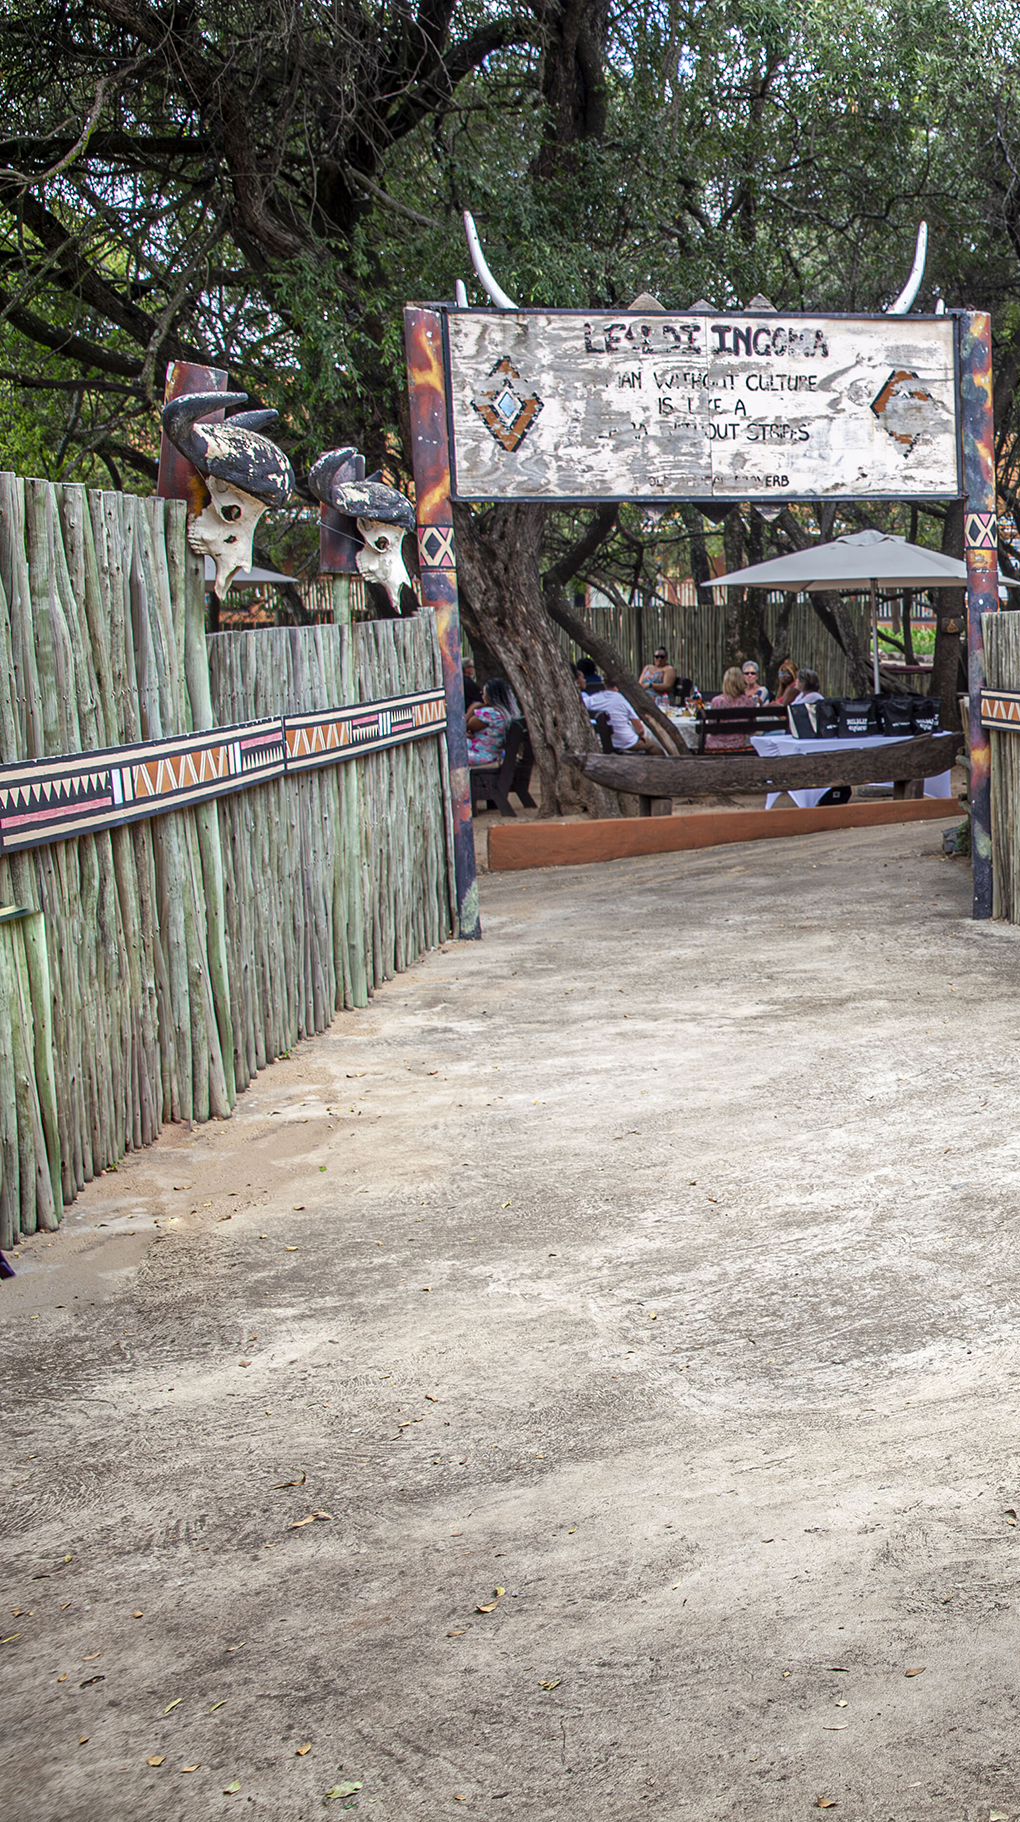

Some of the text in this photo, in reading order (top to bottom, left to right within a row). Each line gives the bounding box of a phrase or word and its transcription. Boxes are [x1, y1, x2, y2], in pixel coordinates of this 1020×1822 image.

[606, 371, 642, 389] AN
[653, 371, 740, 390] WTHOT
[745, 373, 818, 392] CULTURE
[658, 397, 747, 416] IS LE A
